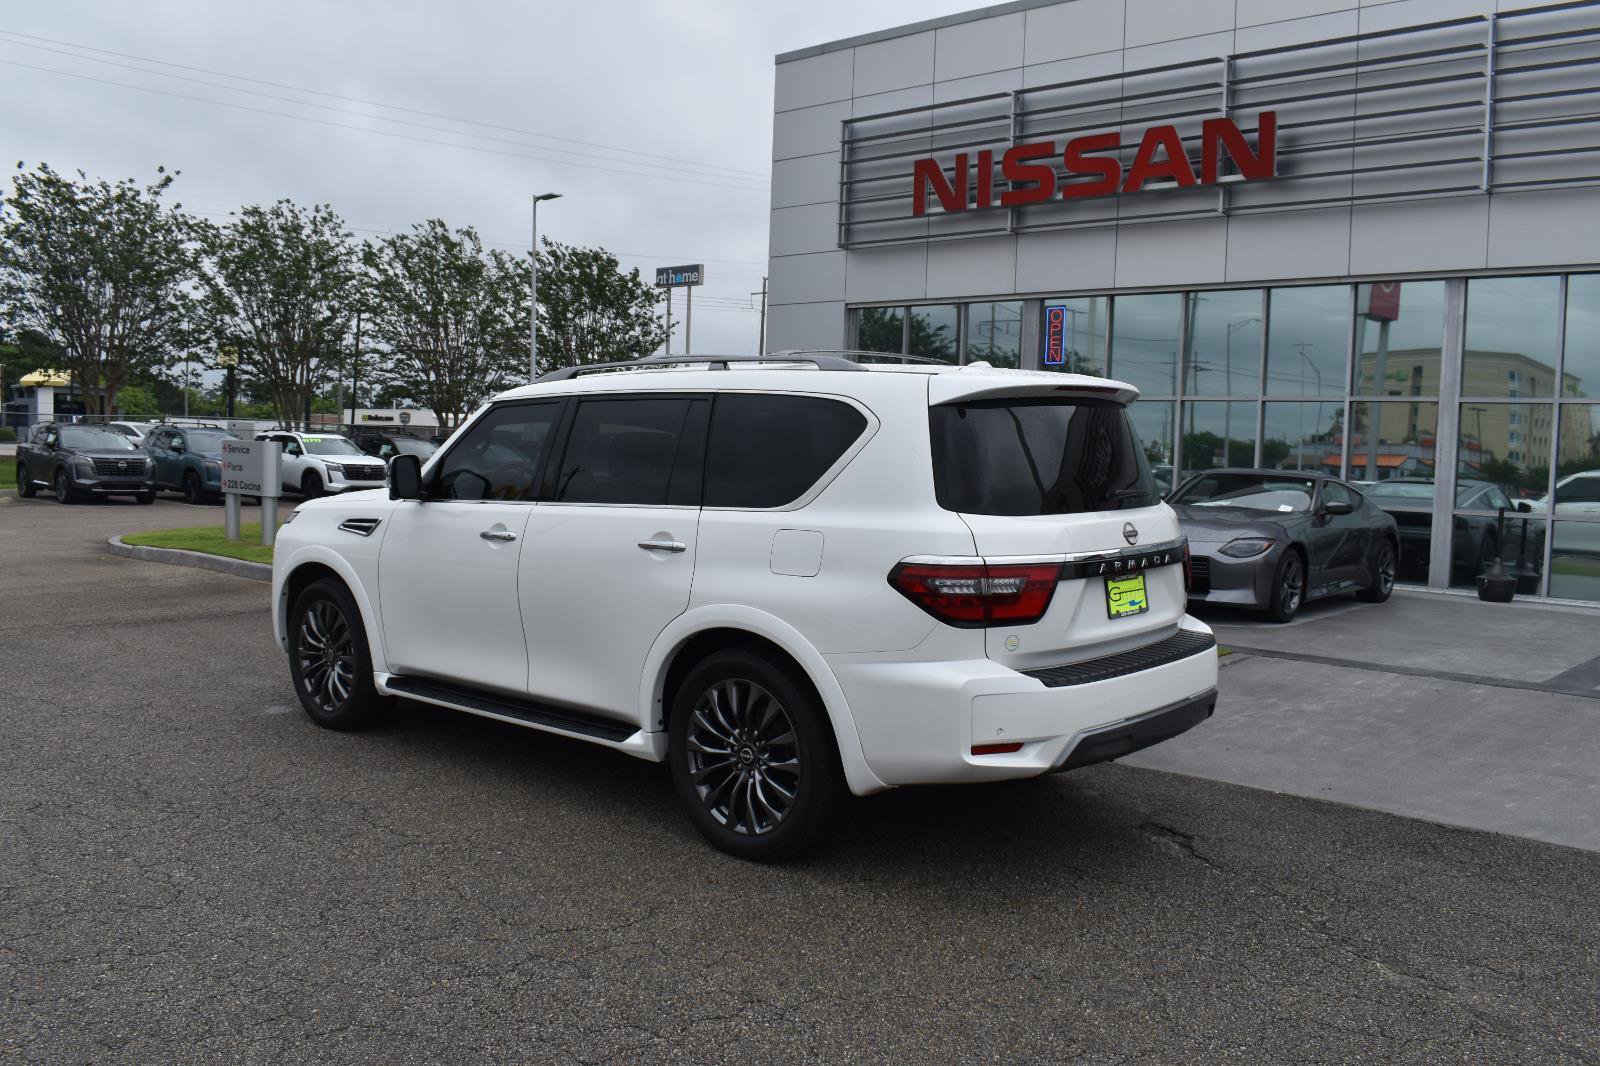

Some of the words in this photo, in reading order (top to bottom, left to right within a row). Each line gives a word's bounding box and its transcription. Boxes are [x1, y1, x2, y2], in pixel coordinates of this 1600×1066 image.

[912, 110, 1277, 217] NISSAN
[669, 270, 699, 283] home
[1050, 310, 1062, 361] OPEN
[227, 443, 250, 455] Service
[227, 461, 243, 472] Parts
[1099, 554, 1170, 573] ARMADA
